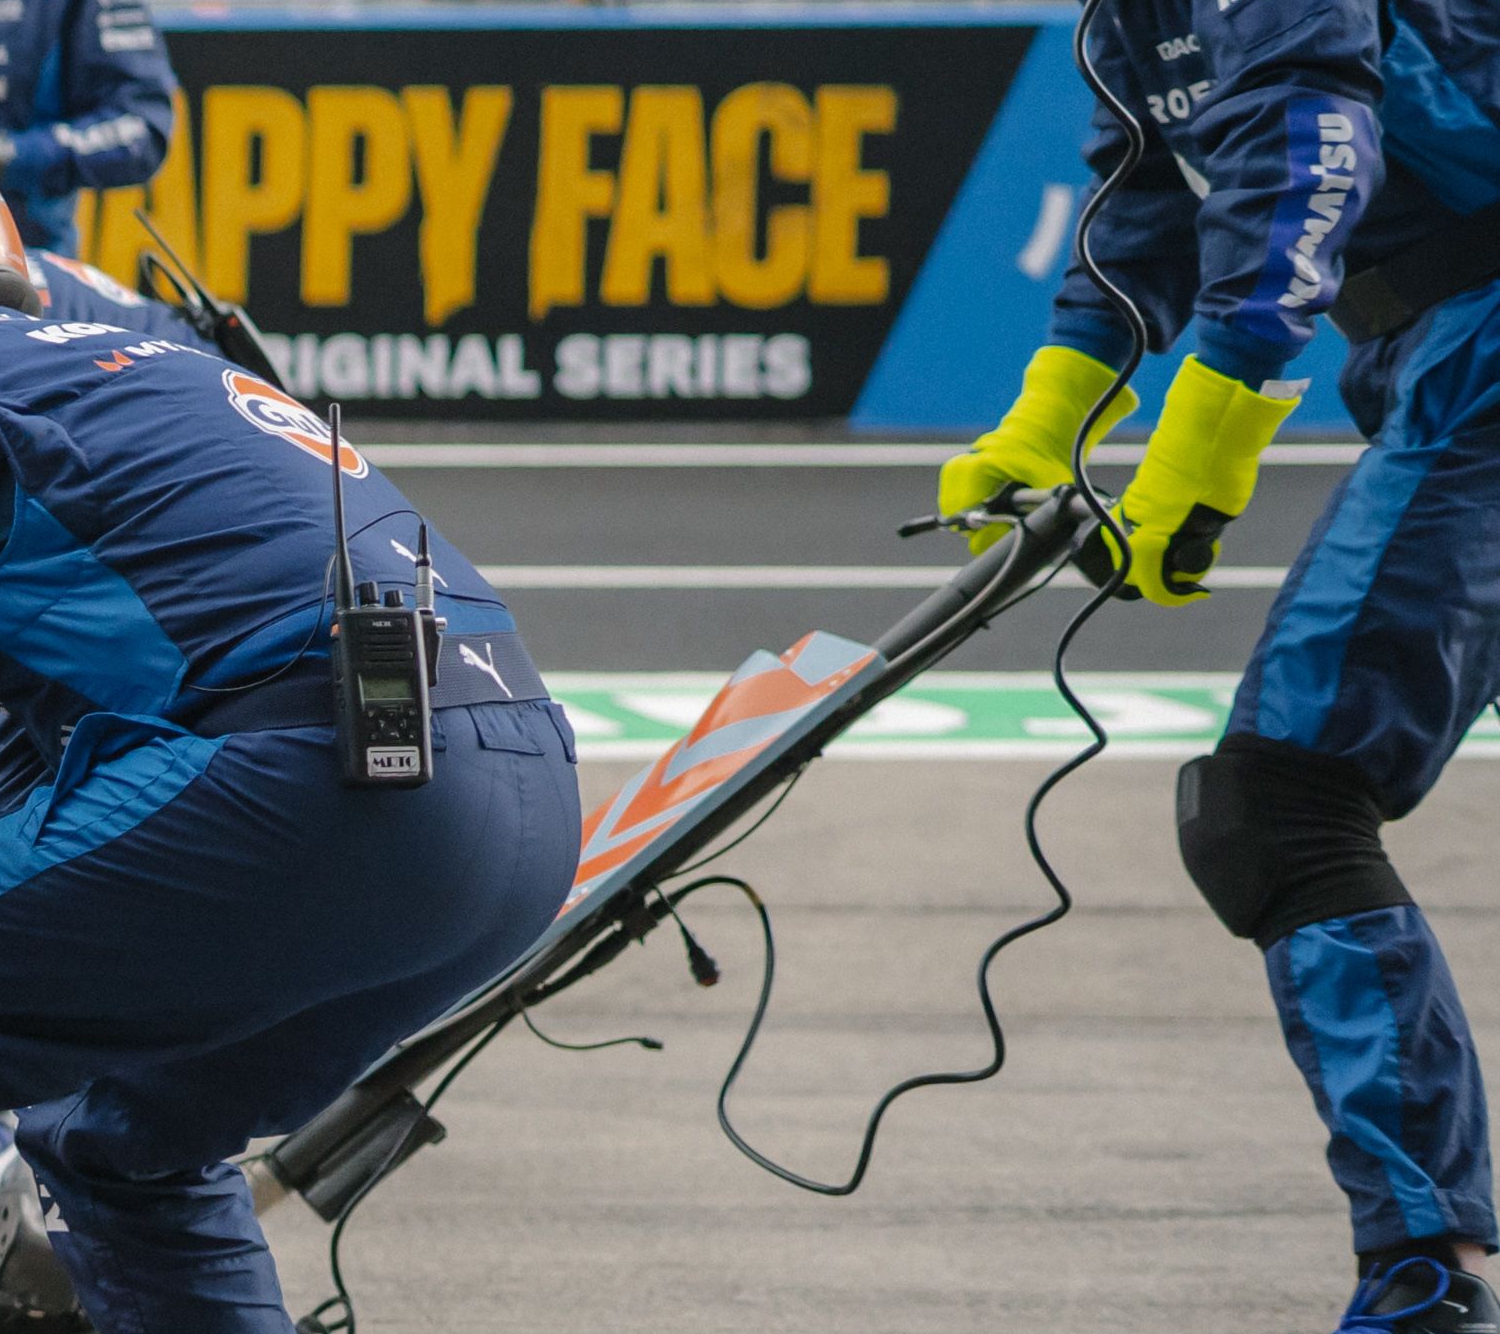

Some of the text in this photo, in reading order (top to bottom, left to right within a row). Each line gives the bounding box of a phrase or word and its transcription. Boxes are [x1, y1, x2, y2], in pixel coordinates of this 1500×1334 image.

[77, 83, 513, 326] APPY
[529, 82, 897, 322] FACE
[555, 333, 812, 400] SERIES
